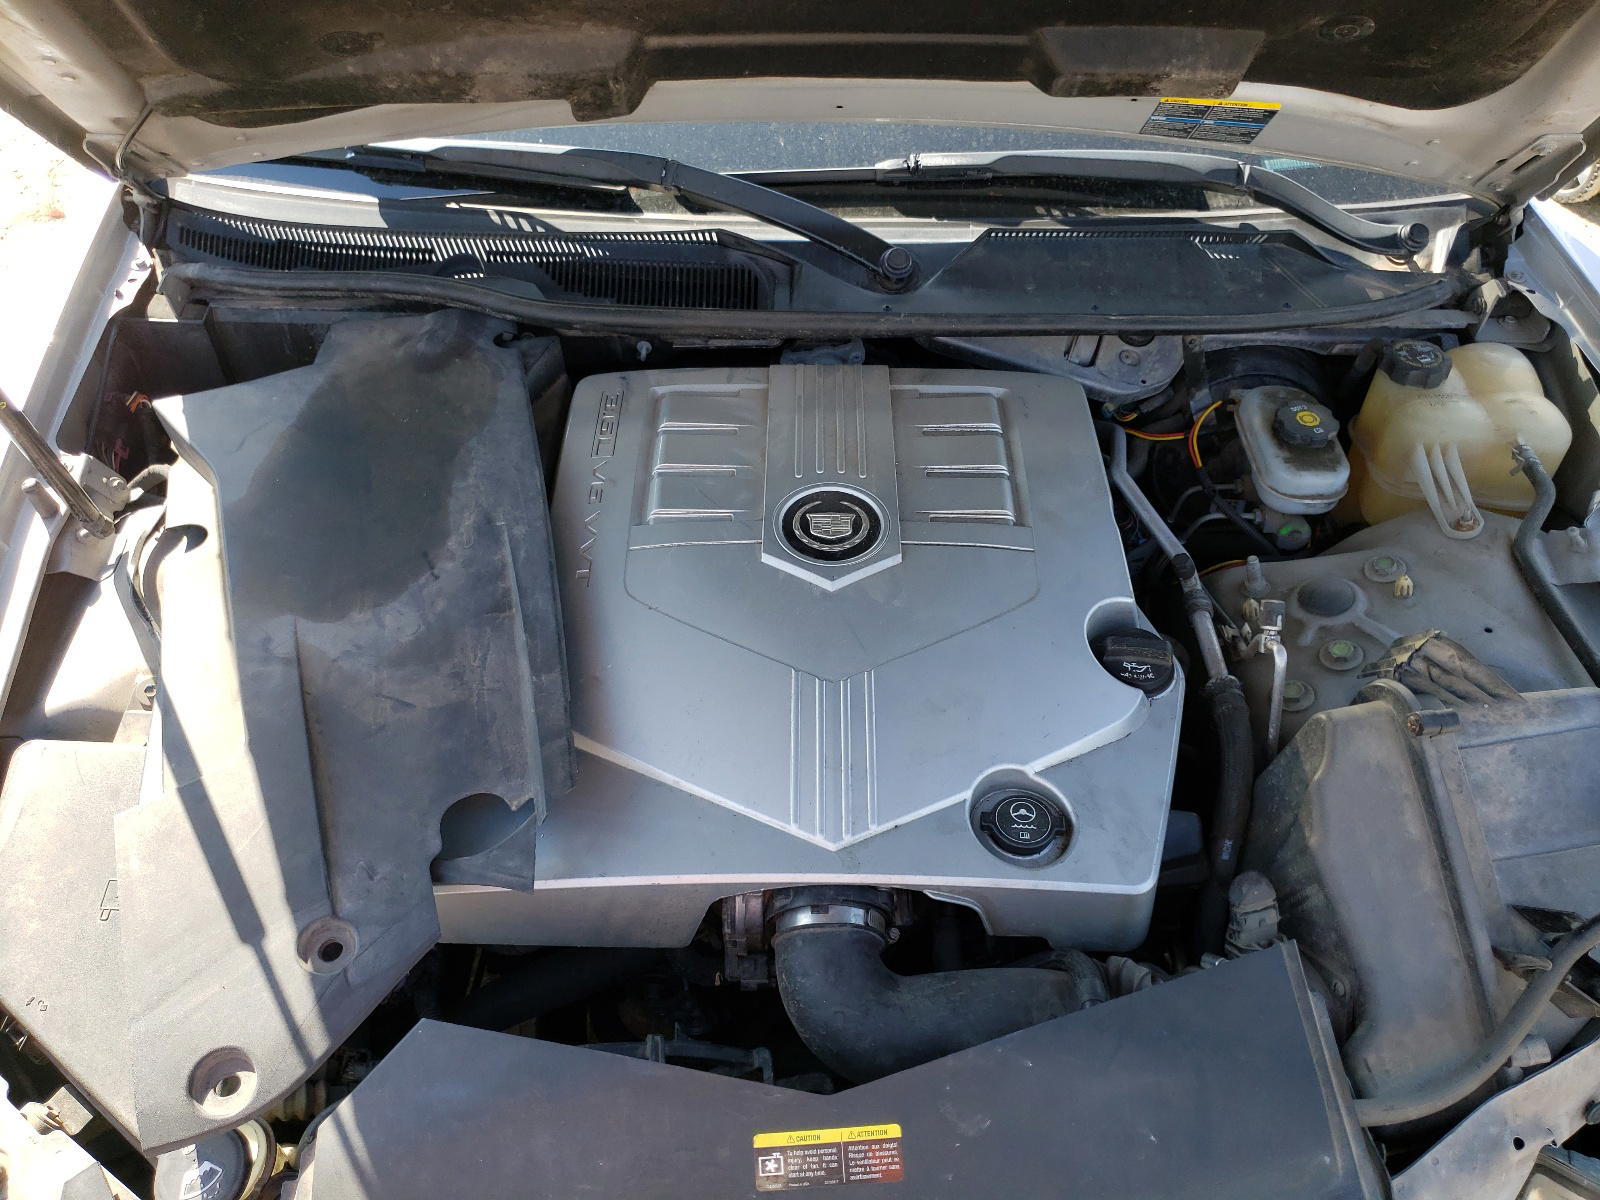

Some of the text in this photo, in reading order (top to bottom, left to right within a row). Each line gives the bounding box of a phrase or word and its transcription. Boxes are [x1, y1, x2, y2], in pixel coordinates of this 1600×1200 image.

[575, 391, 620, 588] 3.6L V6 VVT
[796, 1134, 821, 1142] CAUTION
[857, 1129, 888, 1138] ATTENTION
